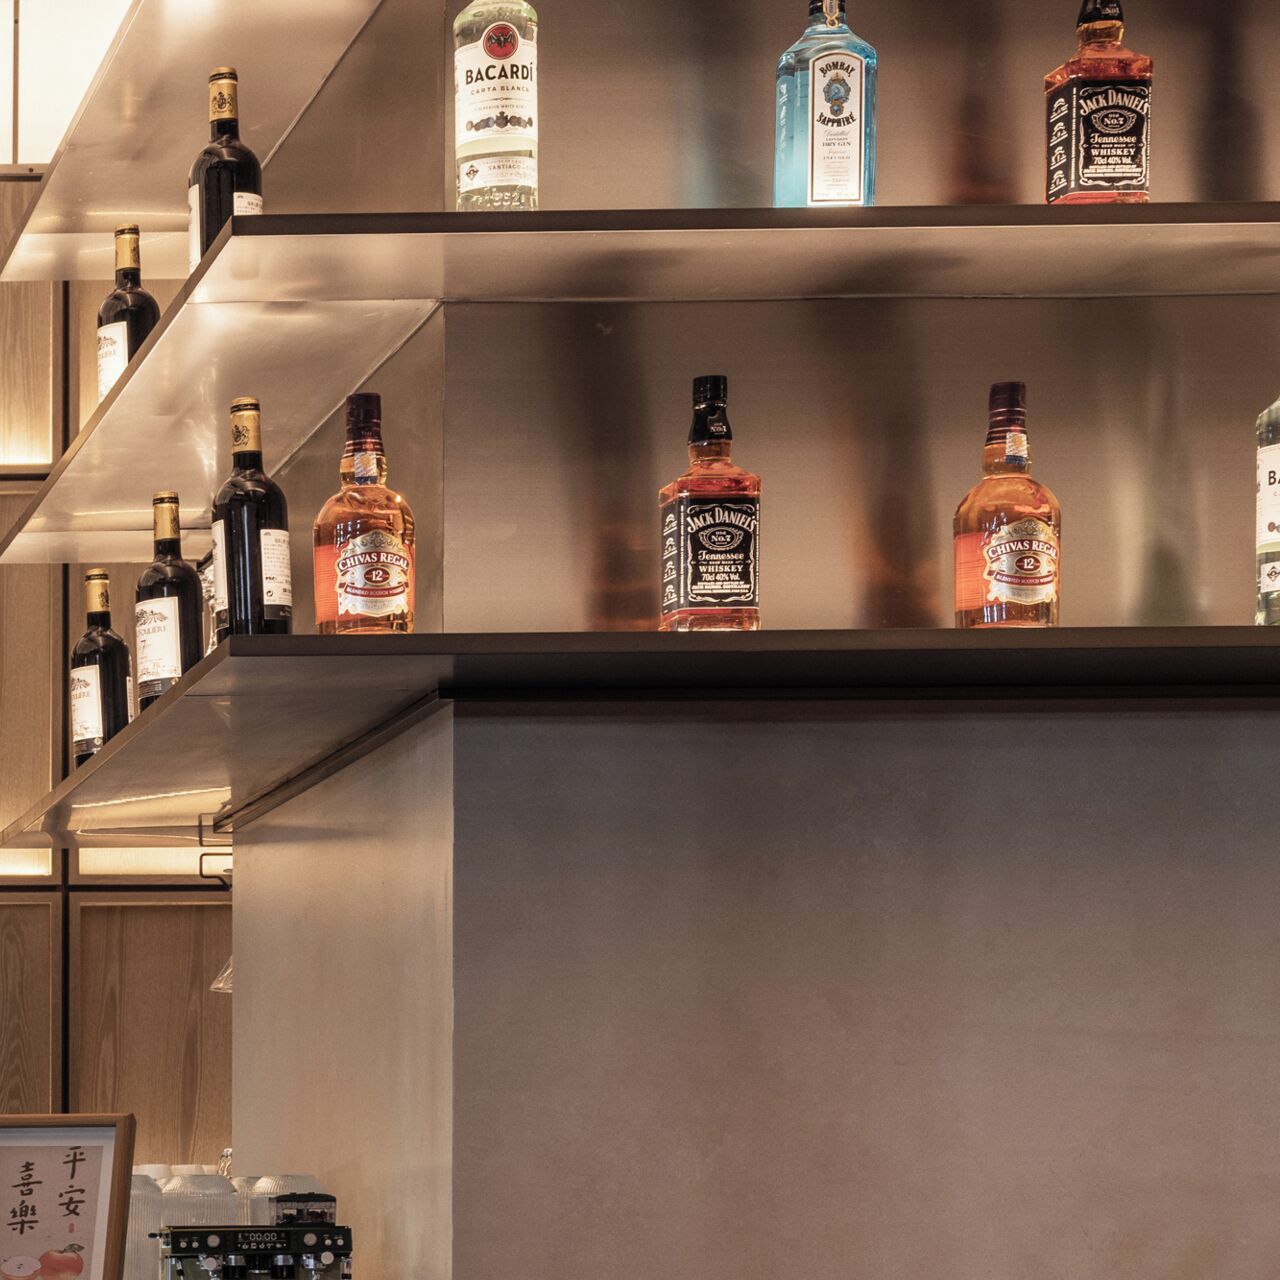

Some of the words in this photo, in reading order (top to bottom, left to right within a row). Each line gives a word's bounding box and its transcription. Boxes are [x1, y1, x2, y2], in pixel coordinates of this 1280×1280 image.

[465, 62, 533, 86] BACARDÍ
[818, 61, 856, 78] BOMBAY
[1078, 96, 1107, 116] JACK
[1108, 89, 1151, 117] DANIEL'S
[816, 112, 857, 127] SAPPHIRE
[1090, 133, 1137, 144] Tennessee
[1091, 148, 1136, 156] WHISKEY
[1093, 157, 1108, 165] 70cl
[1108, 157, 1121, 165] 40%
[686, 514, 713, 533] JACK
[715, 506, 757, 533] DANIEL'S
[711, 535, 731, 543] No.7
[698, 550, 744, 560] Tennessee
[989, 541, 1031, 558] CHIVAS
[1032, 540, 1058, 559] REGAL
[339, 554, 380, 570] CHIVAS
[381, 552, 408, 570] REGAL
[1024, 558, 1034, 568] 12
[699, 564, 744, 572] WHISKEY
[371, 570, 382, 581] 12
[702, 573, 715, 581] 70cl
[716, 573, 729, 581] 40%
[58, 1146, 86, 1217] 平安
[6, 1161, 43, 1235] 喜樂
[249, 1232, 277, 1241] 00:00
